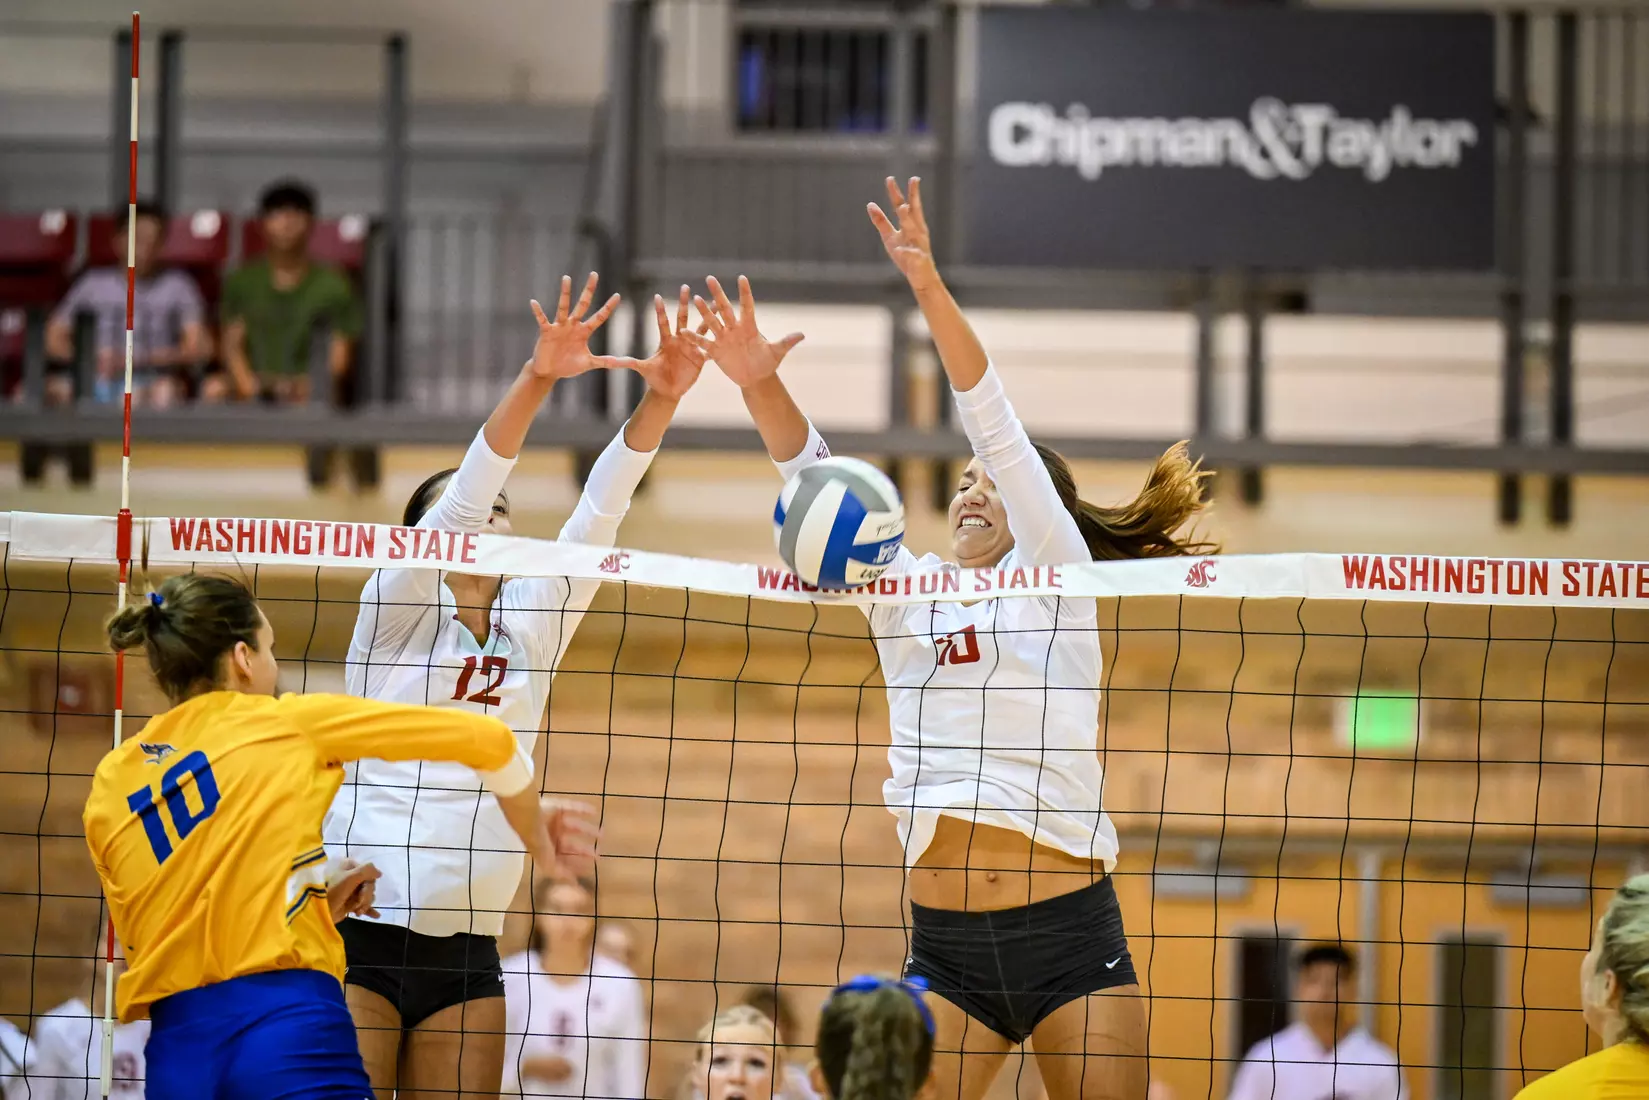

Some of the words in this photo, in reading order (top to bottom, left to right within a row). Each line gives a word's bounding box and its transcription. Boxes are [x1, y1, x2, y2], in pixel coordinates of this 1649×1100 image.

[170, 517, 376, 558] WASHINGTON
[388, 527, 479, 563] STATE
[1342, 555, 1549, 596] WASHINGTON
[1561, 561, 1649, 599] STATE
[450, 655, 508, 706] 12
[126, 750, 222, 866] 10
